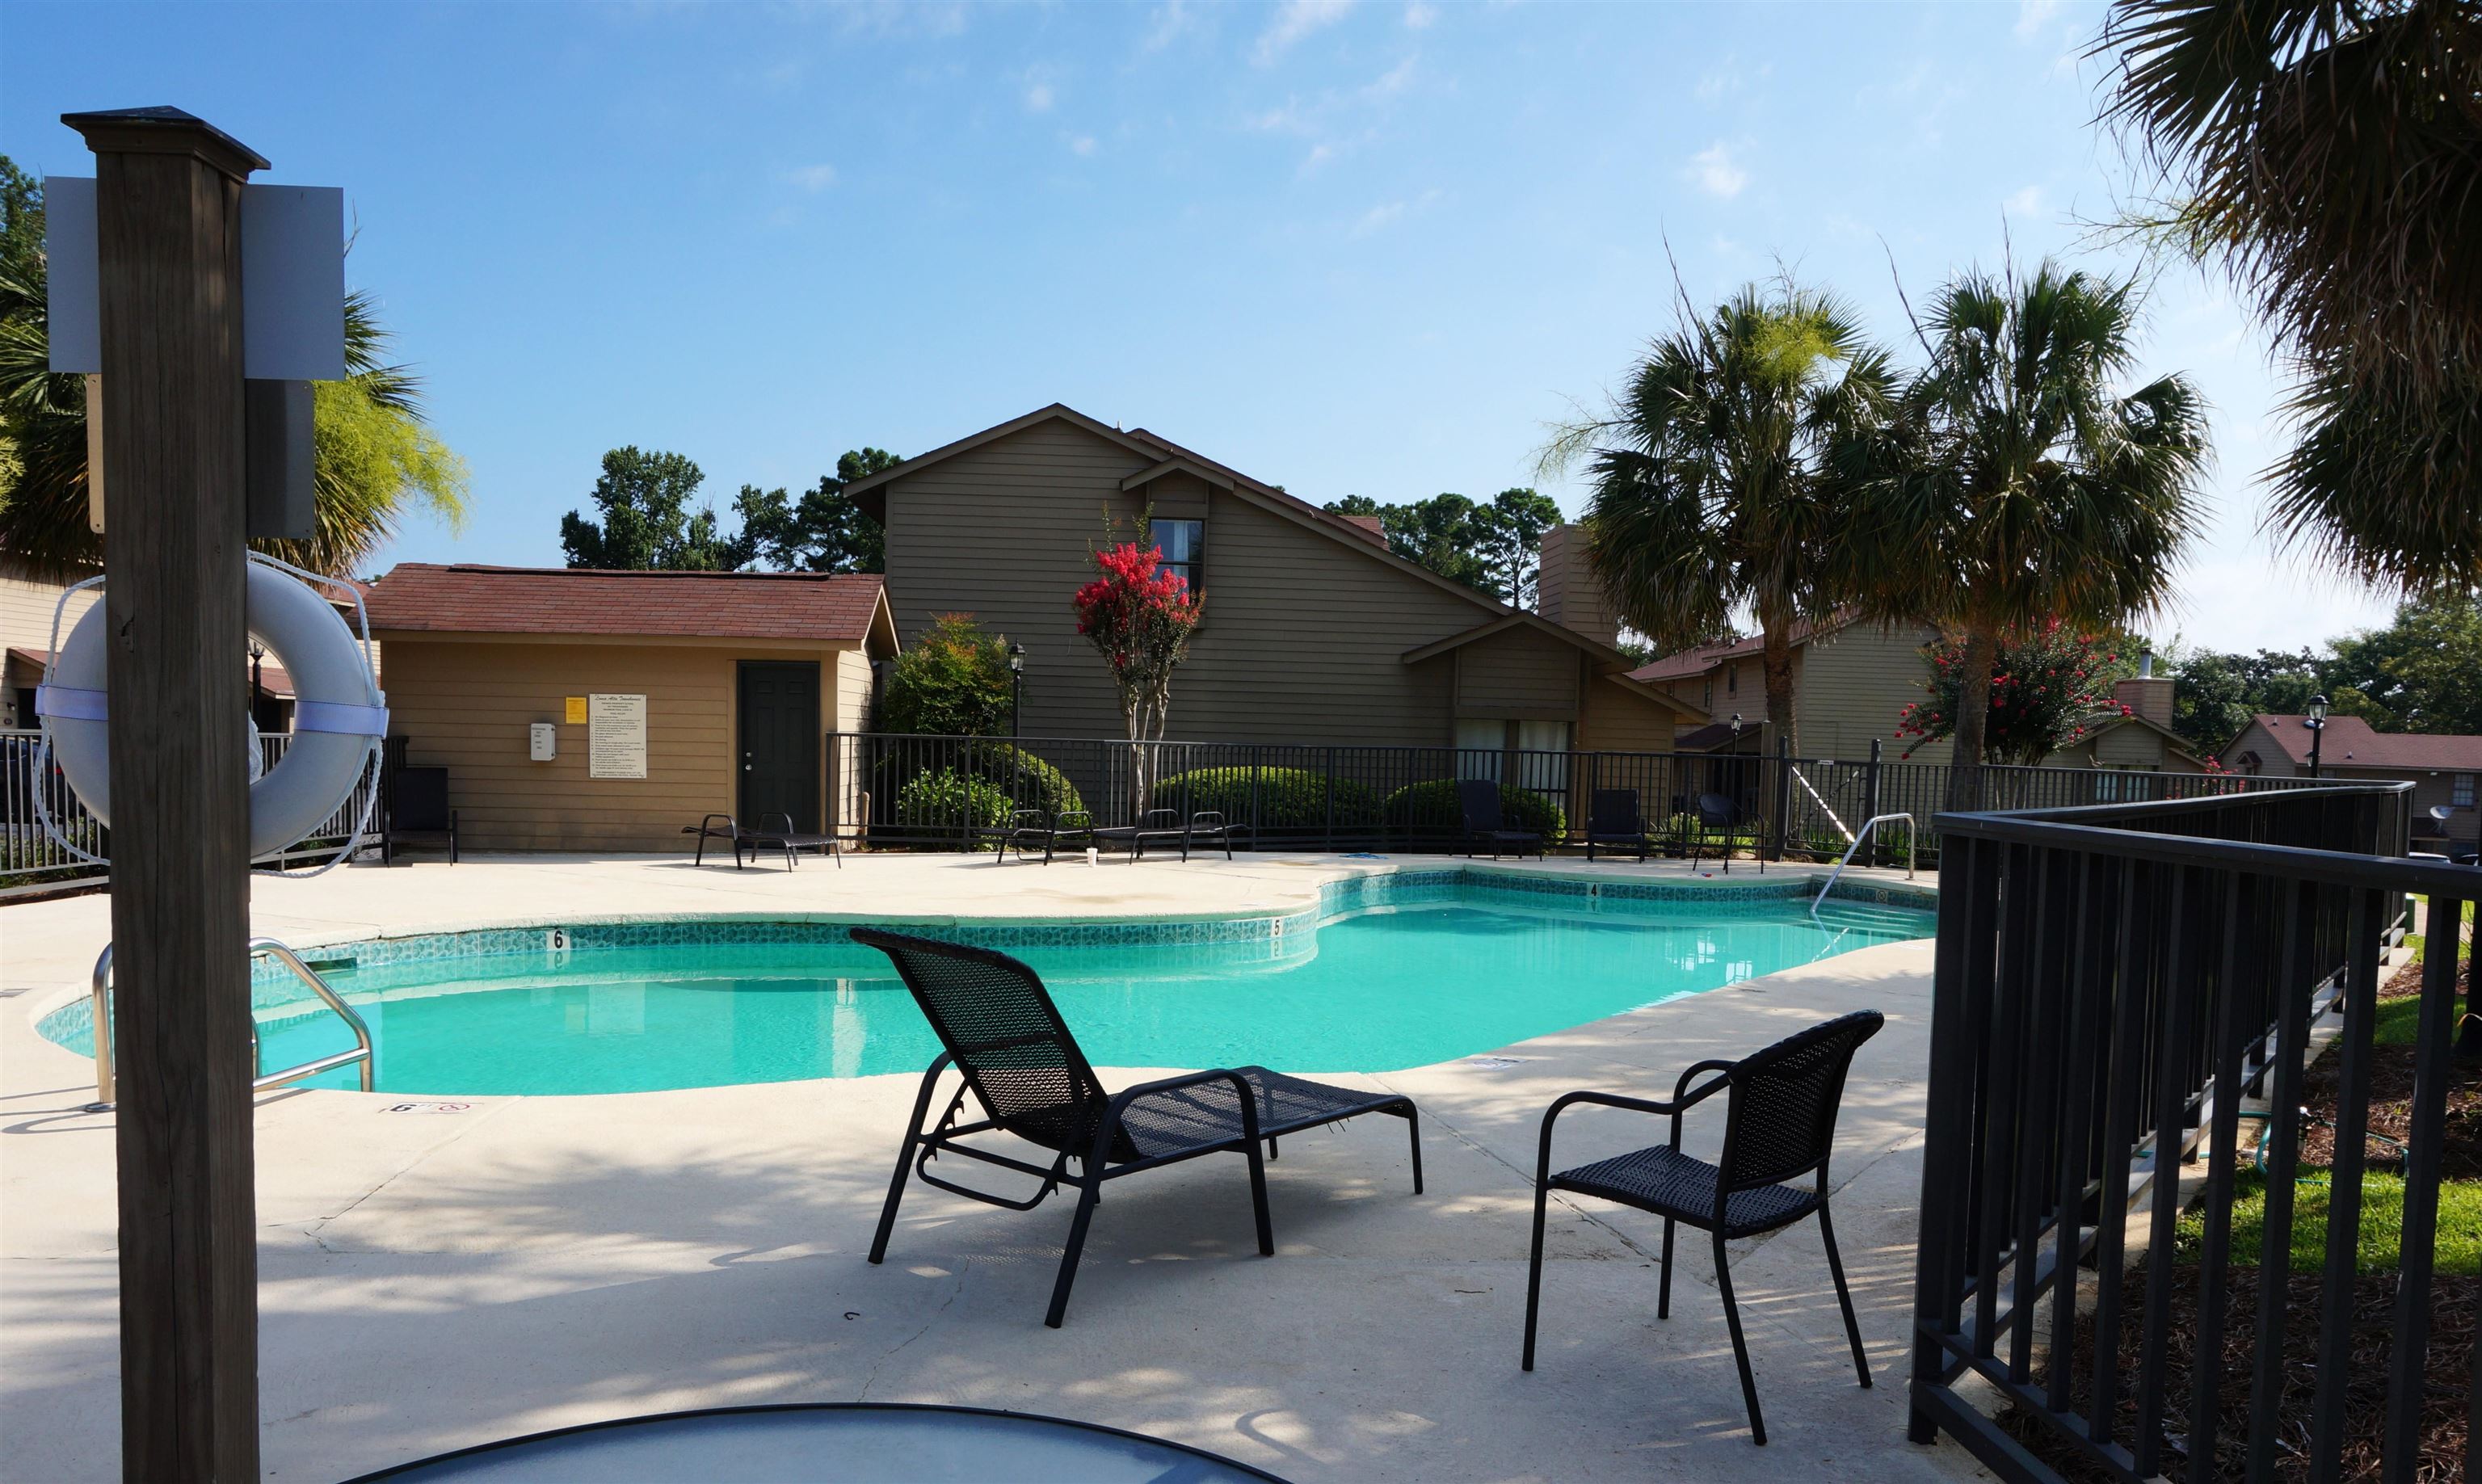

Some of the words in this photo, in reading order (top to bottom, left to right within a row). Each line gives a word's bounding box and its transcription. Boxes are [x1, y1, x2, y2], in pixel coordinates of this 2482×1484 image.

[1591, 884, 1597, 897] 4
[1275, 919, 1280, 935] 5
[554, 930, 563, 948] 6
